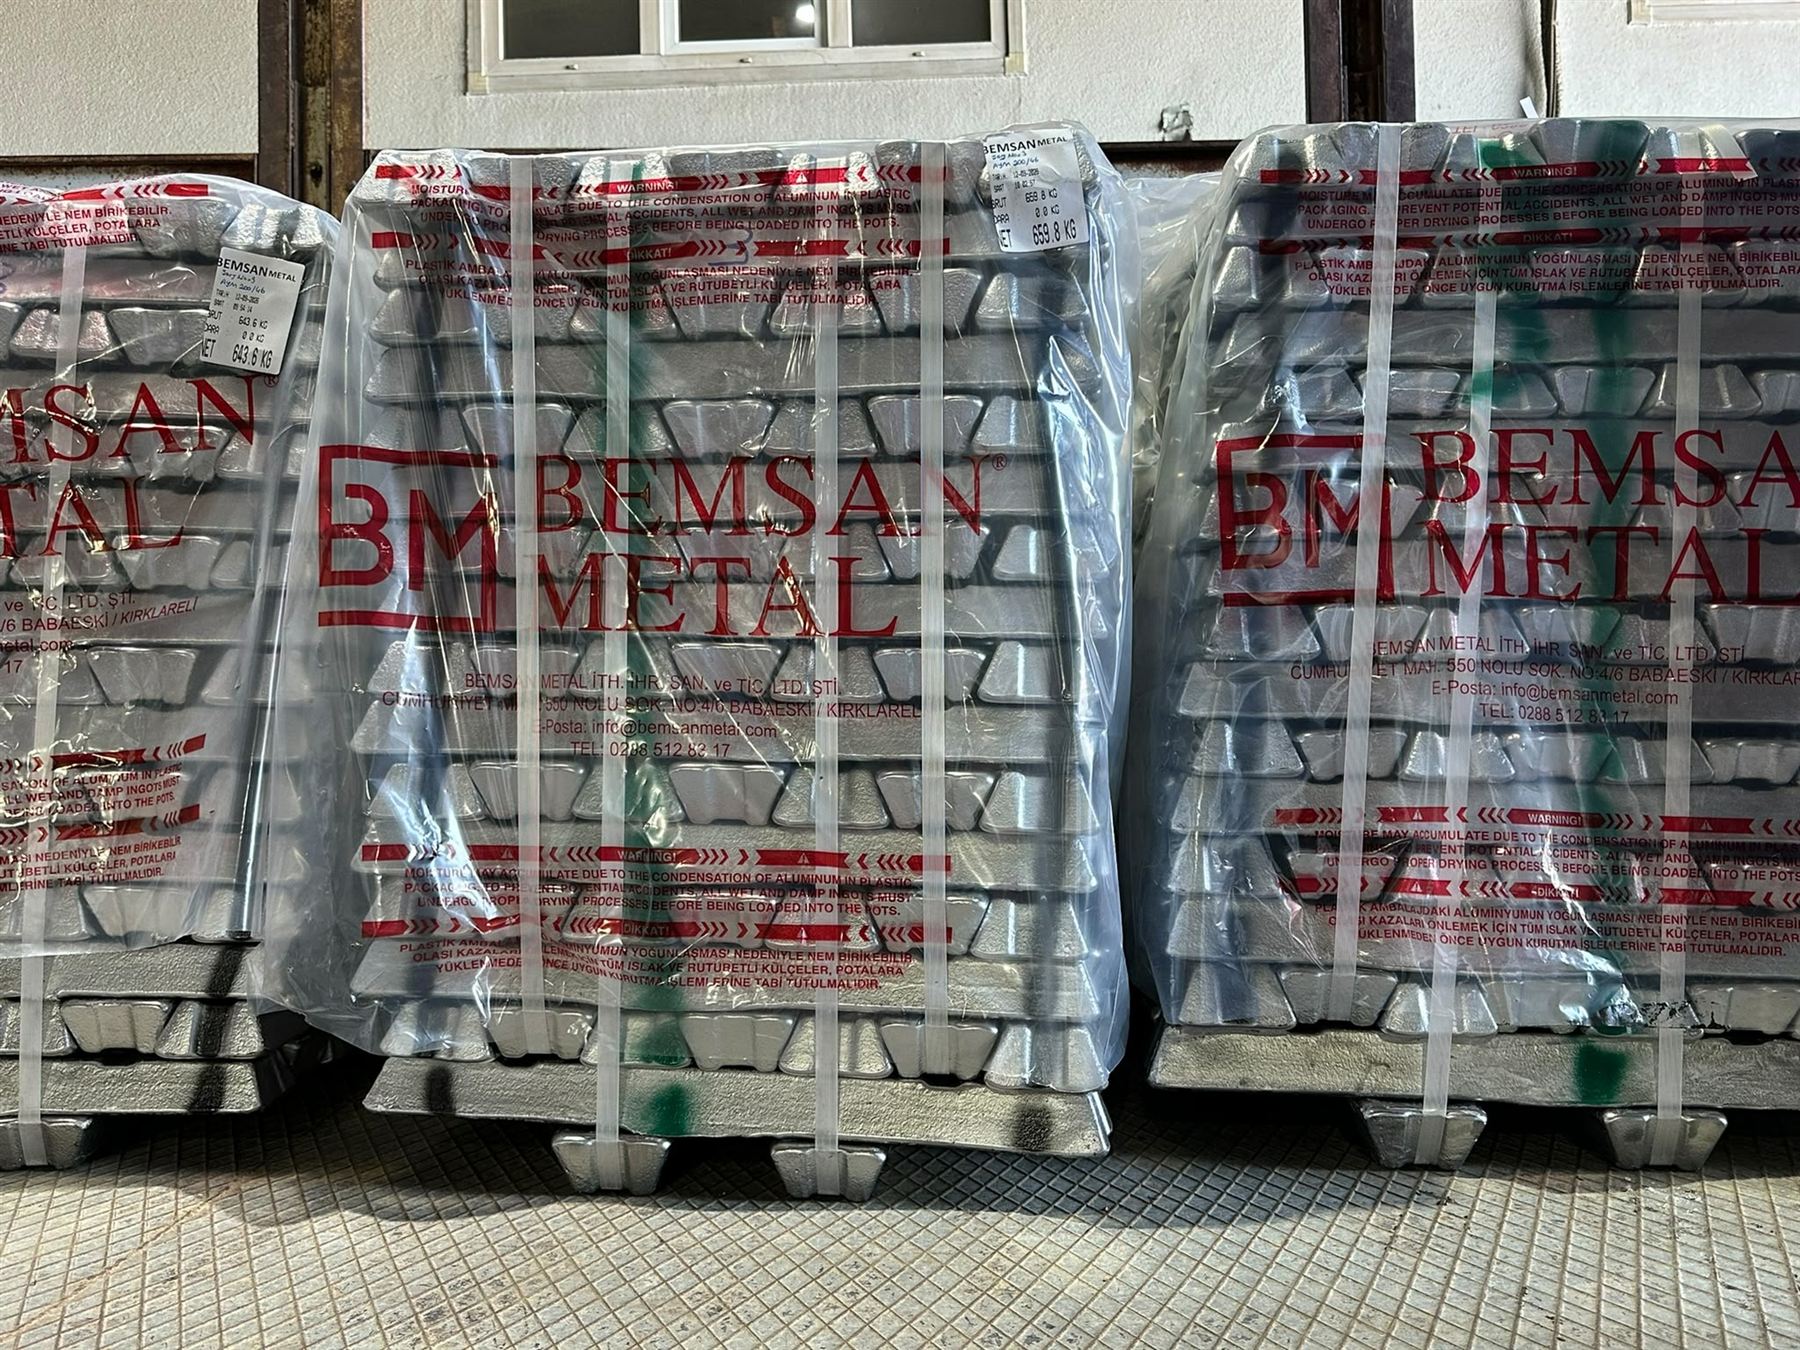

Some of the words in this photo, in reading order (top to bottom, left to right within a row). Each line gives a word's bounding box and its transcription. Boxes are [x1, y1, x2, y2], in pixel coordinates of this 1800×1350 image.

[984, 140, 1036, 154] BEMSAN
[1037, 136, 1067, 146] METAL
[1514, 167, 1577, 177] WARNING!
[1049, 189, 1057, 198] KG
[1477, 187, 1502, 198] DUE
[1656, 181, 1673, 191] OF
[579, 202, 602, 211] DUE
[653, 193, 750, 206] CONDENSATION
[754, 192, 772, 202] OF
[774, 191, 839, 201] ALUMINUM
[861, 189, 910, 200] PLASTIC
[1452, 201, 1519, 213] POTENTIAL
[1603, 197, 1626, 206] ALL
[1631, 195, 1658, 204] WET
[1662, 193, 1688, 203] AND
[1692, 192, 1726, 202] DAMP
[1730, 192, 1777, 202] INGOTS
[65, 209, 91, 219] NEM
[701, 207, 730, 216] ALL
[732, 206, 754, 216] WET
[760, 205, 783, 216] AND
[1051, 205, 1059, 214] KG
[1308, 218, 1367, 229] UNDERGO
[1424, 216, 1470, 227] DRYING
[1473, 213, 1549, 225] PROCESSES
[1553, 209, 1605, 221] BEFORE
[1610, 208, 1648, 218] BEING
[1652, 206, 1703, 217] LOADED
[1707, 206, 1735, 216] INTO
[1739, 206, 1763, 216] THE
[25, 223, 91, 237] KÜLÇELER,
[96, 218, 160, 231] POTALARA
[652, 220, 702, 232] BEFORE
[706, 219, 744, 230] BEING
[749, 218, 799, 230] LOADED
[804, 218, 832, 228] INTO
[836, 217, 859, 228] THE
[864, 217, 900, 228] POTS.
[1033, 222, 1060, 245] 659.8
[1064, 219, 1076, 239] KG
[23, 240, 49, 251] TABİ
[1708, 252, 1734, 261] NEM
[269, 271, 296, 282] METAL
[1308, 272, 1342, 281] OLASI
[1502, 267, 1527, 278] TÜM
[1572, 268, 1586, 277] VE
[608, 289, 629, 298] TÜM
[671, 284, 685, 292] VE
[1460, 282, 1503, 293] UYGUN
[1506, 280, 1566, 293] KURUTMA
[1654, 279, 1684, 289] TABİ
[233, 344, 258, 366] 643.6
[261, 349, 272, 368] KG
[537, 453, 991, 537] BEMSAN
[319, 466, 498, 611] BM
[1415, 520, 1800, 608] METAL
[536, 553, 898, 638] METAL
[5, 601, 23, 611] ve
[22, 613, 109, 632] BABAESKİ
[1440, 637, 1495, 652] METAL
[1615, 648, 1633, 659] ve
[6, 660, 22, 673] 17
[1447, 658, 1476, 672] 550
[1480, 660, 1524, 675] NOLU
[1528, 663, 1565, 678] SOK.
[540, 674, 586, 688] METAL
[715, 681, 731, 691] ve
[1432, 681, 1496, 695] E-Posta:
[1501, 682, 1678, 705] info@bemsanmetal.com
[546, 697, 568, 710] 550
[571, 697, 619, 710] NOLU
[730, 700, 812, 717] BABAESKİ
[1480, 703, 1514, 718] TEL:
[1519, 705, 1551, 721] 0288
[1556, 707, 1582, 722] 512
[1614, 711, 1628, 724] 17
[570, 742, 603, 756] TEL:
[653, 743, 682, 757] 512
[713, 744, 730, 757] 17
[26, 792, 54, 803] WET
[127, 782, 162, 794] INGOTS
[136, 798, 153, 807] THE
[1528, 814, 1581, 825] WARNING!
[1412, 830, 1489, 841] ACCUMULATE
[1494, 830, 1519, 841] DUE
[1521, 833, 1536, 842] TO
[1661, 839, 1676, 849] OF
[110, 846, 131, 855] NEM
[1664, 853, 1691, 863] AND
[1439, 859, 1487, 870] DRYING
[1562, 862, 1608, 874] BEFORE
[1611, 864, 1650, 876] BEING
[1654, 867, 1702, 878] LOADED
[1710, 868, 1738, 879] INTO
[1742, 869, 1766, 880] THE
[582, 870, 607, 879] DUE
[611, 870, 625, 878] TO
[629, 871, 649, 880] THE
[652, 872, 750, 883] CONDENSATION
[755, 873, 771, 883] OF
[776, 873, 844, 885] ALUMINUM
[845, 876, 856, 885] IN
[860, 876, 911, 888] PLASTIC
[761, 887, 786, 898] AND
[790, 889, 825, 899] DAMP
[652, 901, 701, 910] BEFORE
[707, 901, 744, 912] BEING
[749, 902, 800, 913] LOADED
[804, 903, 833, 913] INTO
[837, 903, 861, 913] THE
[866, 904, 900, 916] POTS.
[1369, 917, 1424, 927] KAZALARI
[1492, 920, 1516, 933] İÇİN
[1521, 923, 1544, 933] TÜM
[1546, 924, 1577, 935] ISLAK
[1711, 916, 1738, 927] NEM
[1440, 934, 1474, 946] ÖNCE
[1478, 936, 1523, 947] UYGUN
[1526, 937, 1576, 948] KURUTMA
[1660, 941, 1687, 952] TABİ
[413, 950, 452, 962] OLASI
[601, 959, 624, 970] TÜM
[628, 960, 664, 971] ISLAK
[836, 965, 903, 976] POTALARA
[808, 951, 835, 962] NEM
